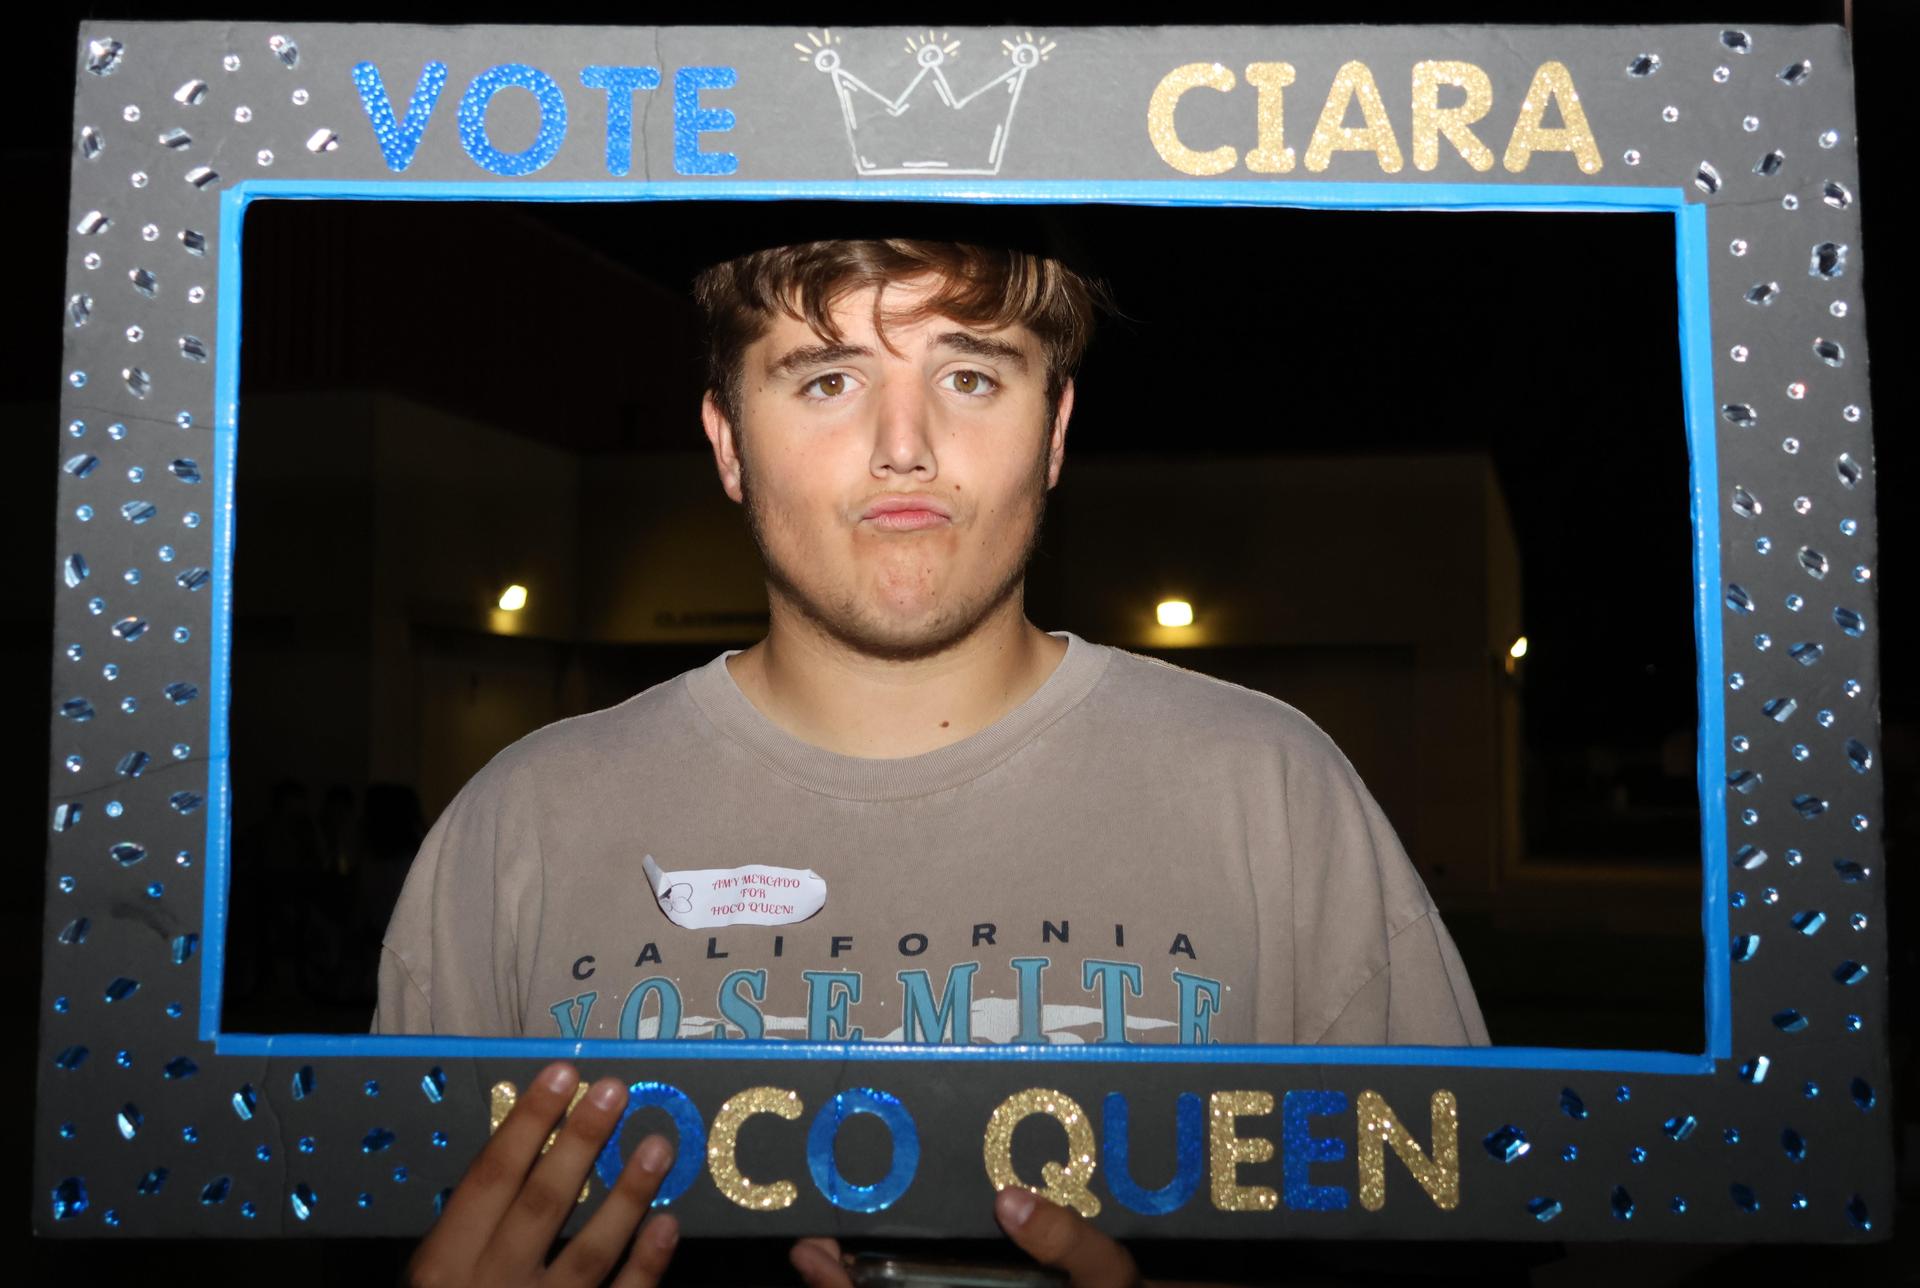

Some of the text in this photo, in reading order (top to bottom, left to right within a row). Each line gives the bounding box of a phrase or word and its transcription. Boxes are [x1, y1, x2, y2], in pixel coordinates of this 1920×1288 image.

[352, 60, 1603, 176] VOTE CIARA
[711, 902, 794, 915] HOCO QUEEN!
[712, 875, 801, 890] AMY MERCADO
[740, 887, 766, 899] FOR
[572, 920, 1197, 980] CALIFORNIA
[550, 956, 1221, 1043] YOSEMITE
[983, 1087, 1460, 1218] QUEEN
